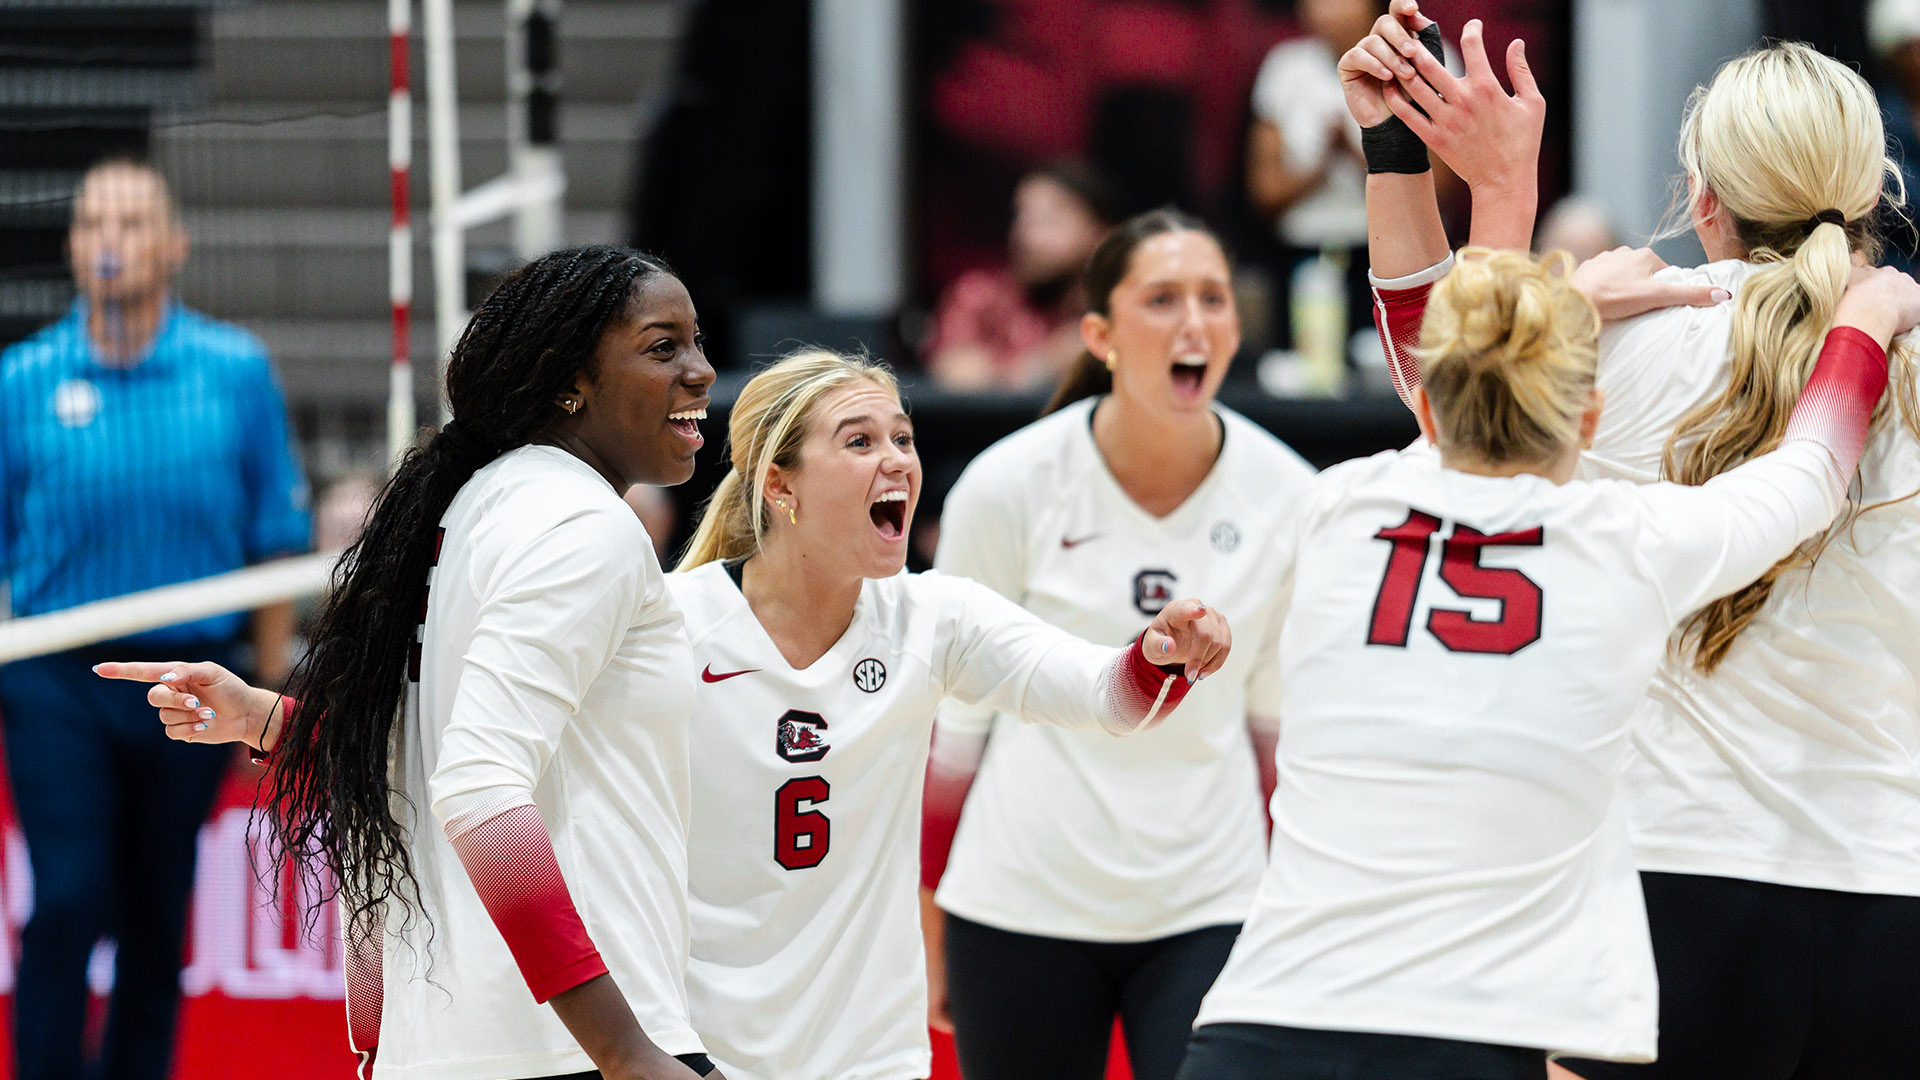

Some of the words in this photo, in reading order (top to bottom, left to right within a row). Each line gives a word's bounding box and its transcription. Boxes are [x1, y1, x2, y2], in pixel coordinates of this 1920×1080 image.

[1366, 508, 1544, 656] 15
[854, 660, 885, 692] SEC
[774, 775, 831, 871] 6
